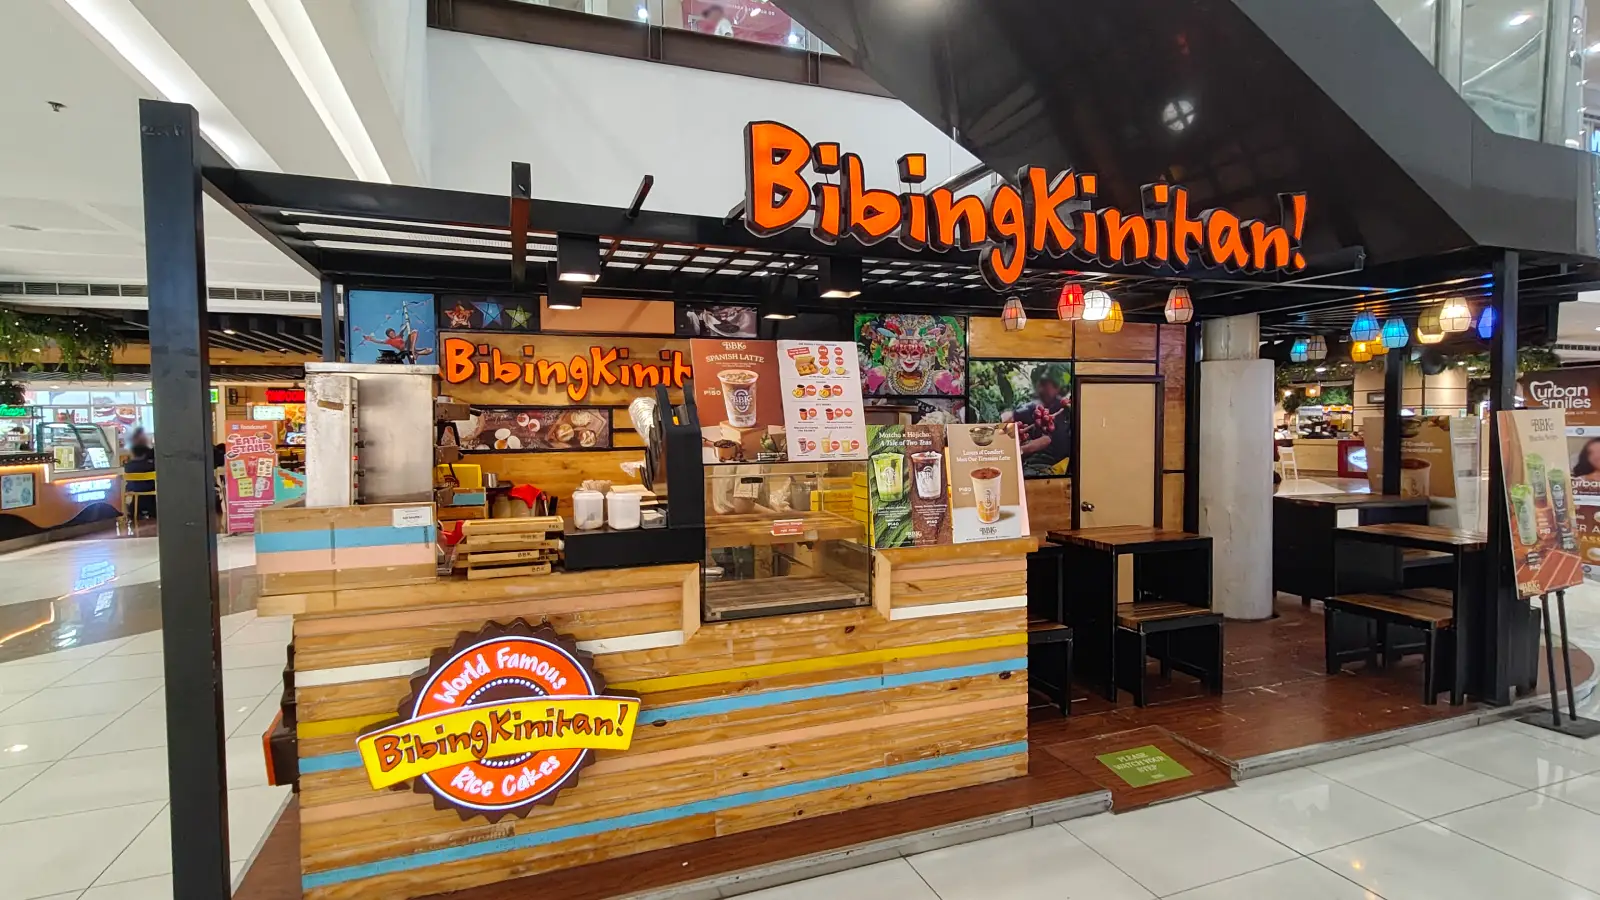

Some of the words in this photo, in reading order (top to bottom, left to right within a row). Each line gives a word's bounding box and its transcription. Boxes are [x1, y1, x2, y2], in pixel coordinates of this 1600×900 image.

[743, 119, 1308, 292] BibingKinitan!
[721, 341, 747, 350] BBK
[705, 353, 739, 363] SPANISH
[739, 353, 765, 363] LATTE
[444, 337, 694, 402] BibingKinit
[1530, 380, 1589, 402] urban
[1541, 396, 1592, 409] smiles
[1530, 418, 1555, 432] BBK
[232, 444, 270, 453] STAMP
[433, 654, 491, 704] World
[496, 646, 567, 690] Famous
[373, 703, 629, 773] BibingKinitan!
[450, 766, 495, 797] Rice
[501, 755, 560, 797] Cakes
